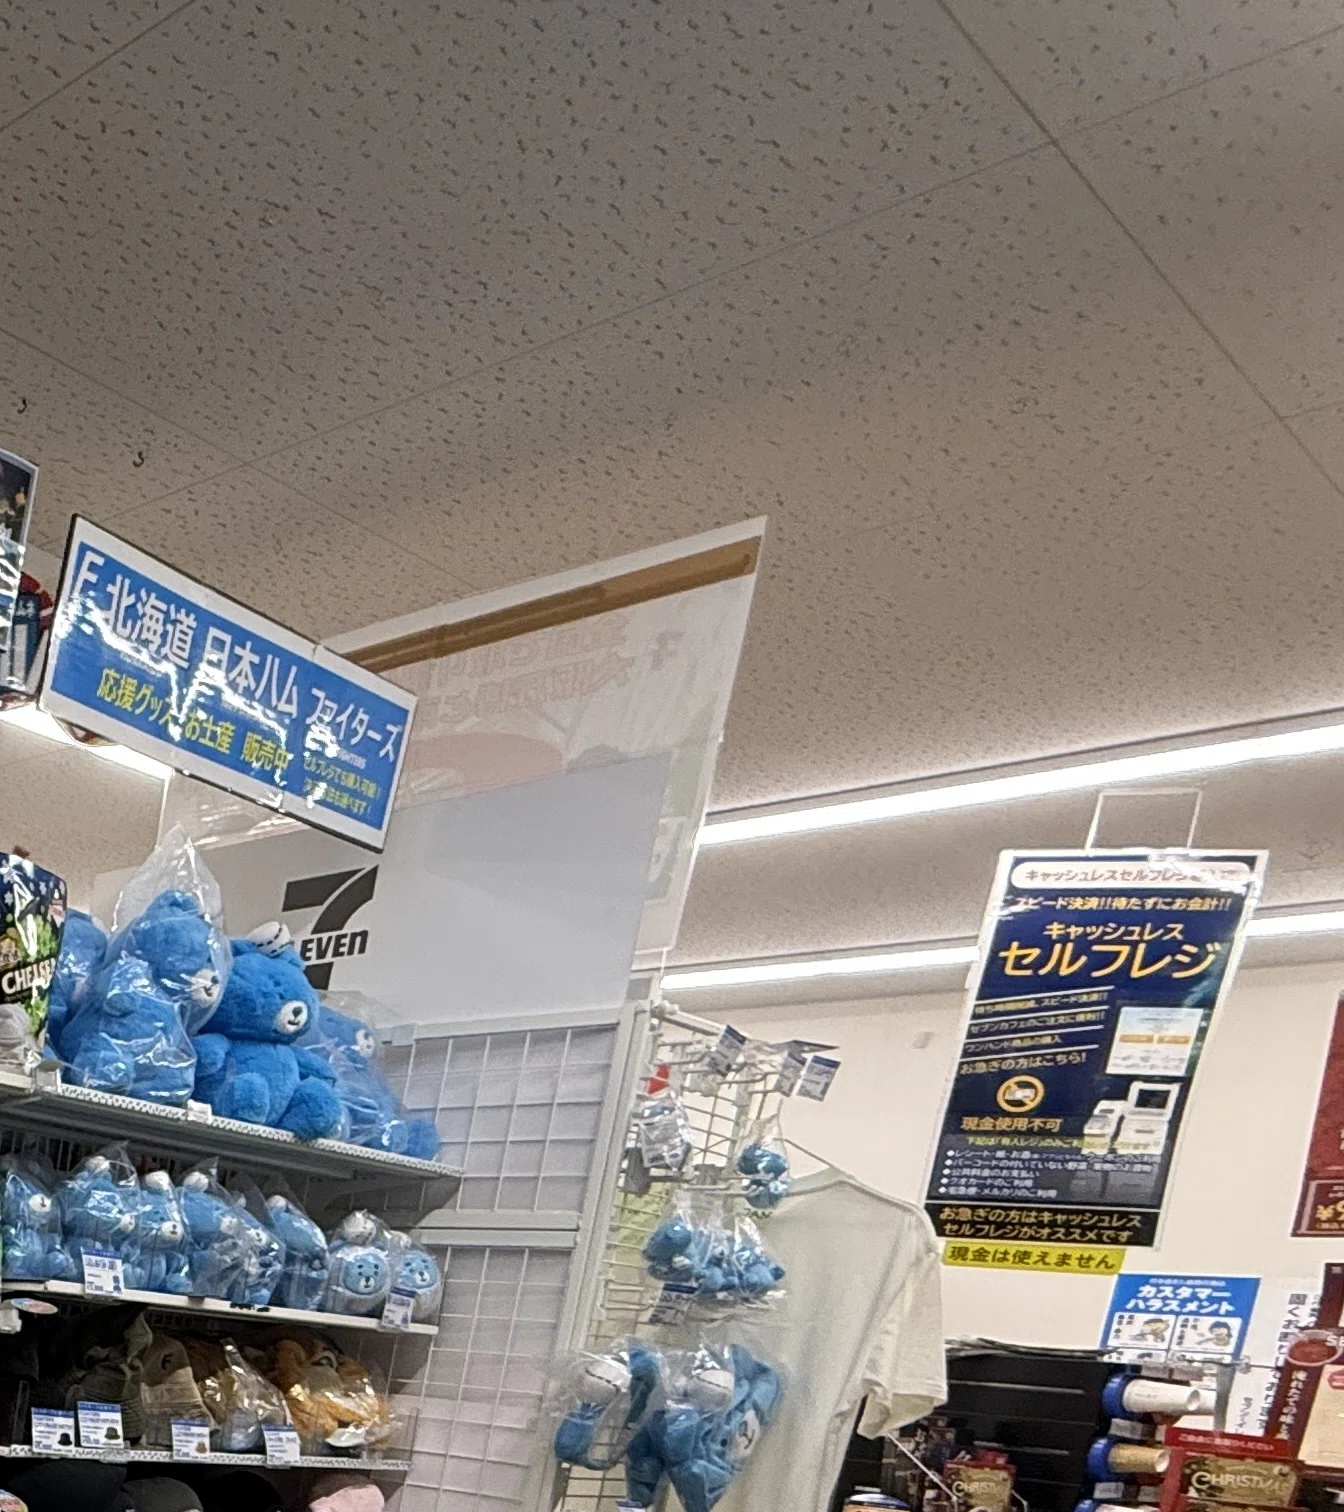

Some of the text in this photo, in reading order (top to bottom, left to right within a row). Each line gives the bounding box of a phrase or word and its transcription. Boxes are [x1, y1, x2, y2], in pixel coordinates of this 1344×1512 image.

[106, 573, 198, 670] 北海道
[204, 625, 299, 719] 日本ハム
[184, 711, 236, 753] お土産
[240, 731, 290, 772] 販売中
[1043, 921, 1185, 941] キャッシュレス
[999, 940, 1222, 979] セルフレジ
[960, 1116, 1063, 1132] 現金使用不可
[939, 1206, 1142, 1228] お急ぎの方はキャッシュレス
[943, 1223, 1133, 1243] セルフレジがオススメです
[948, 1245, 1117, 1271] 現金は使えません
[1137, 1284, 1232, 1301] カスタマー
[1125, 1298, 1236, 1316] ハラスメント
